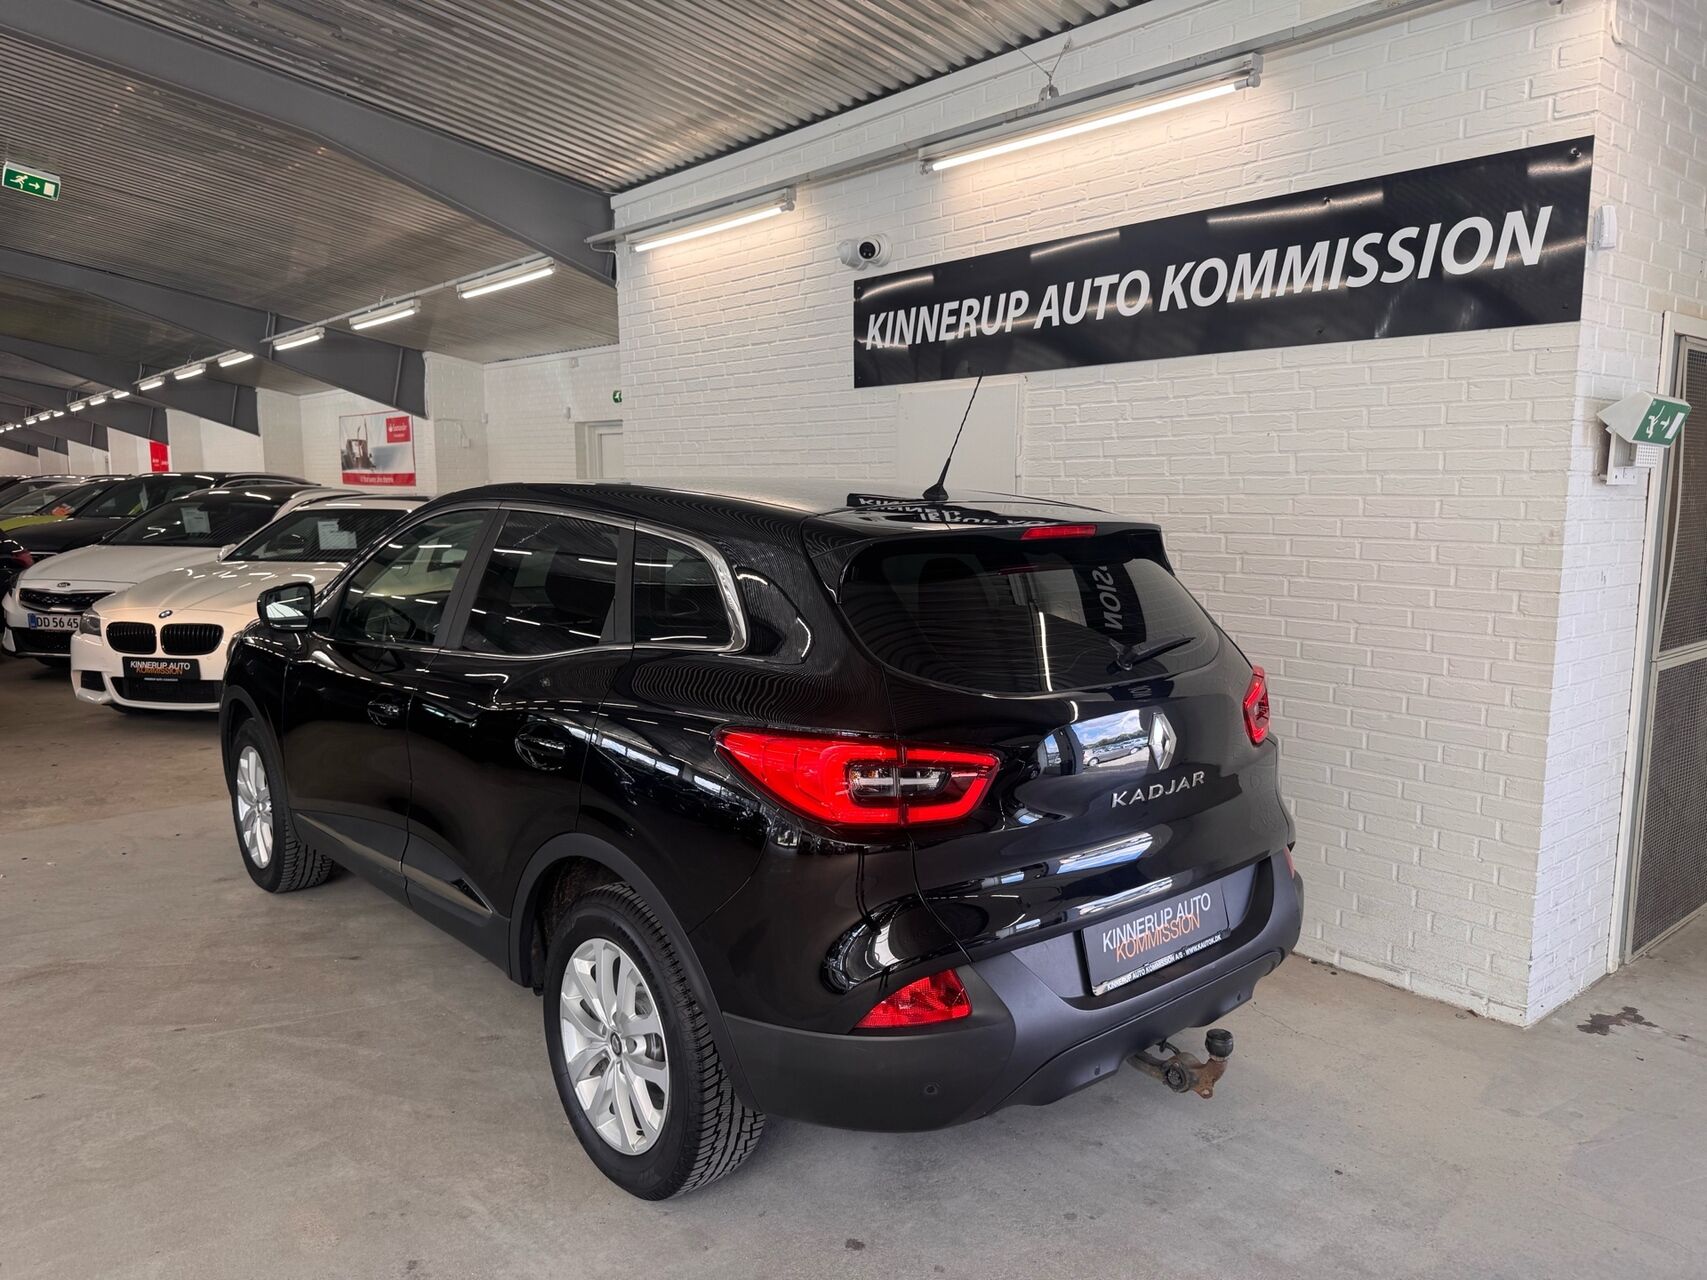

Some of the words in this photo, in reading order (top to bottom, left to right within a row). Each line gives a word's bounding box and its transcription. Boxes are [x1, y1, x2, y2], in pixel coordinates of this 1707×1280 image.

[865, 294, 1029, 349] KINNERUP
[1034, 270, 1151, 330] AUTO
[1160, 206, 1552, 312] KOMMISSION
[36, 616, 50, 629] DD
[52, 617, 65, 628] 56
[67, 618, 79, 628] 45
[130, 661, 168, 669] KINNERUP
[168, 662, 191, 671] AUTO
[1111, 771, 1205, 808] KADJAR
[1102, 907, 1173, 953] KINNERUP
[1176, 892, 1211, 924] AUTO
[1115, 912, 1200, 963] KOMMISSION
[1132, 967, 1146, 979] AUTO
